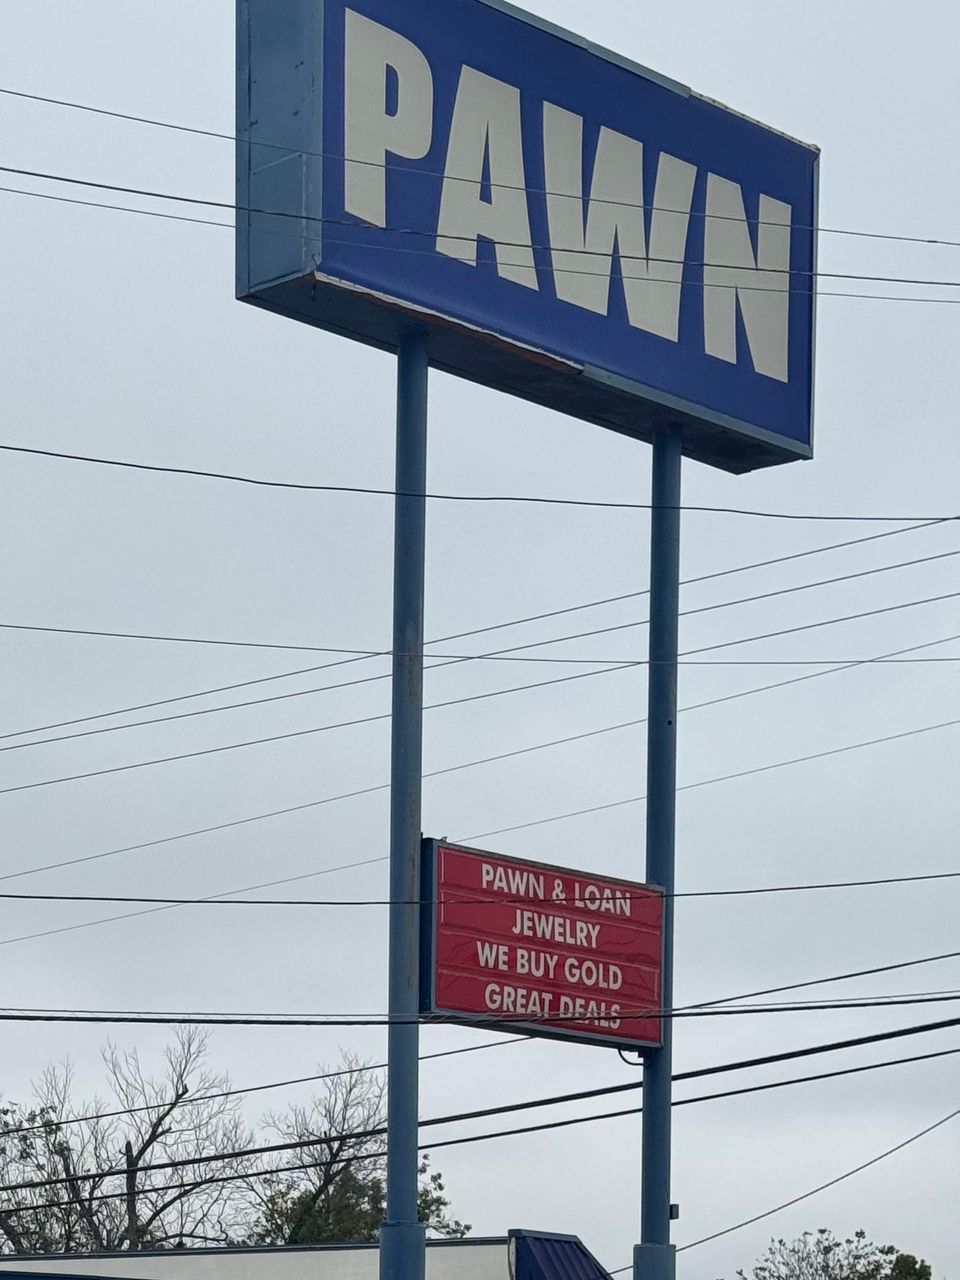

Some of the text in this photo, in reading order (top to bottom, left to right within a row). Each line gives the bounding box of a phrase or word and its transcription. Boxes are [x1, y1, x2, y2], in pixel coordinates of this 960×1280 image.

[344, 7, 792, 384] PAWN
[481, 863, 632, 917] PAWN & LOAN
[511, 909, 601, 948] JEWELRY
[476, 941, 623, 990] WE BUY GOLD
[484, 983, 621, 1030] GREAT DEALS
